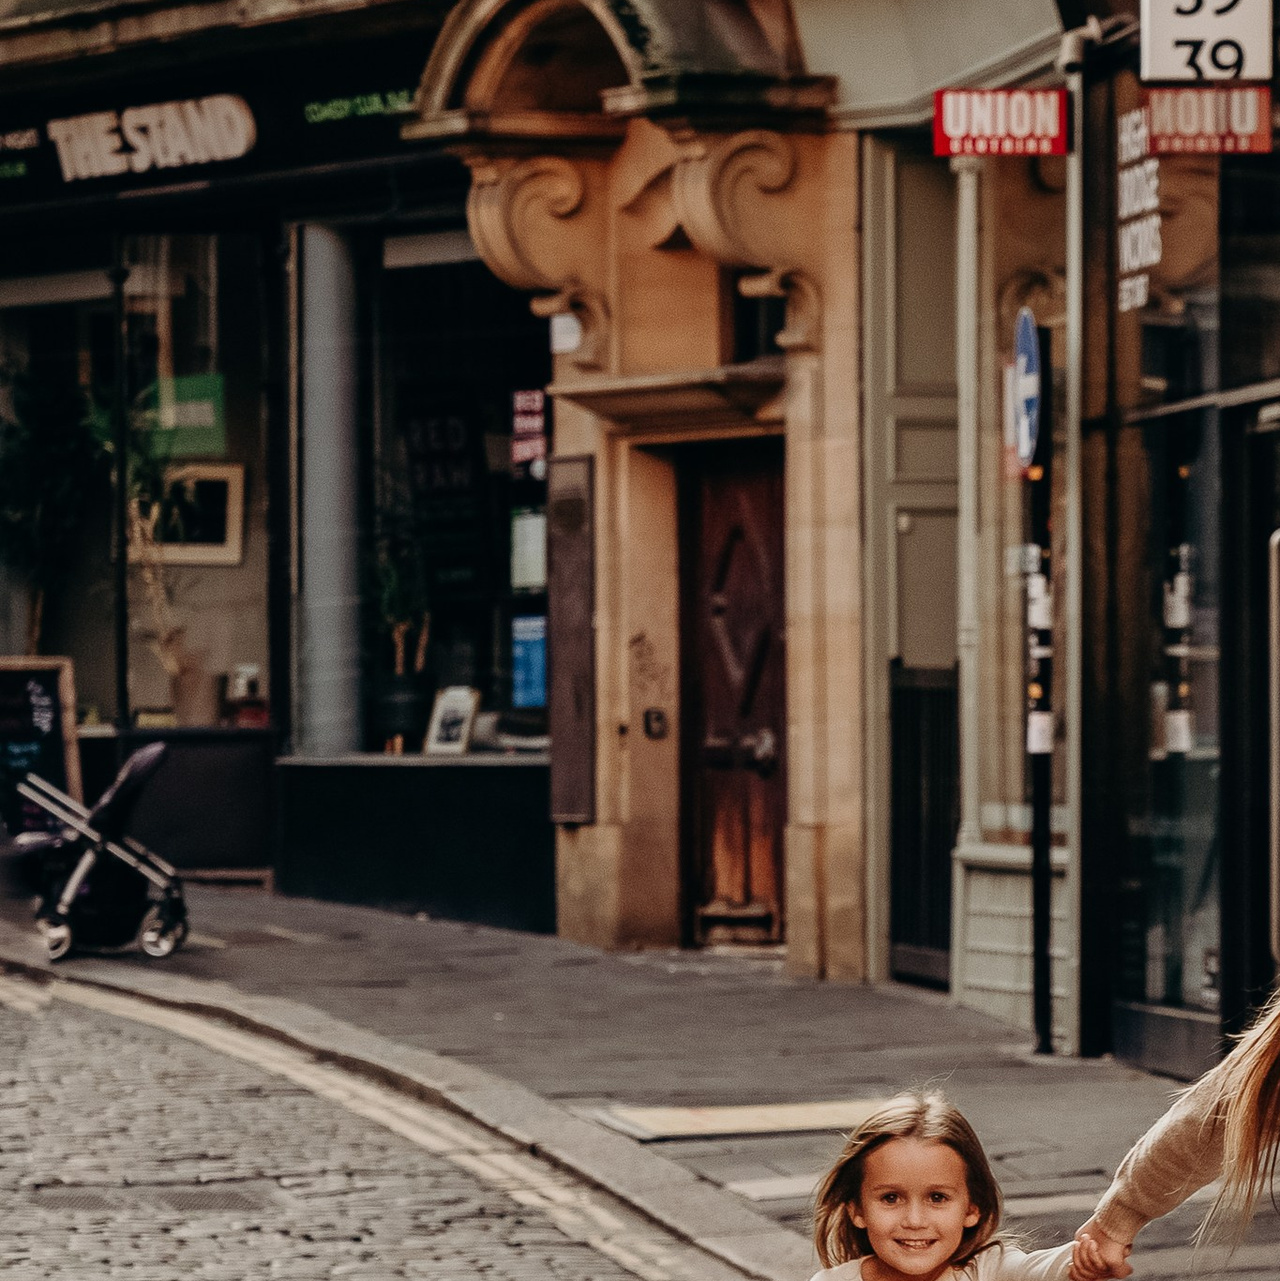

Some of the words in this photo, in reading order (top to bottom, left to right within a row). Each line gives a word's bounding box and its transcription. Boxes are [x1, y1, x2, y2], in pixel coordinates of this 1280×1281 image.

[1172, 39, 1244, 81] 39
[47, 111, 130, 183] THE
[121, 93, 257, 174] STAND
[942, 90, 1060, 138] UNION
